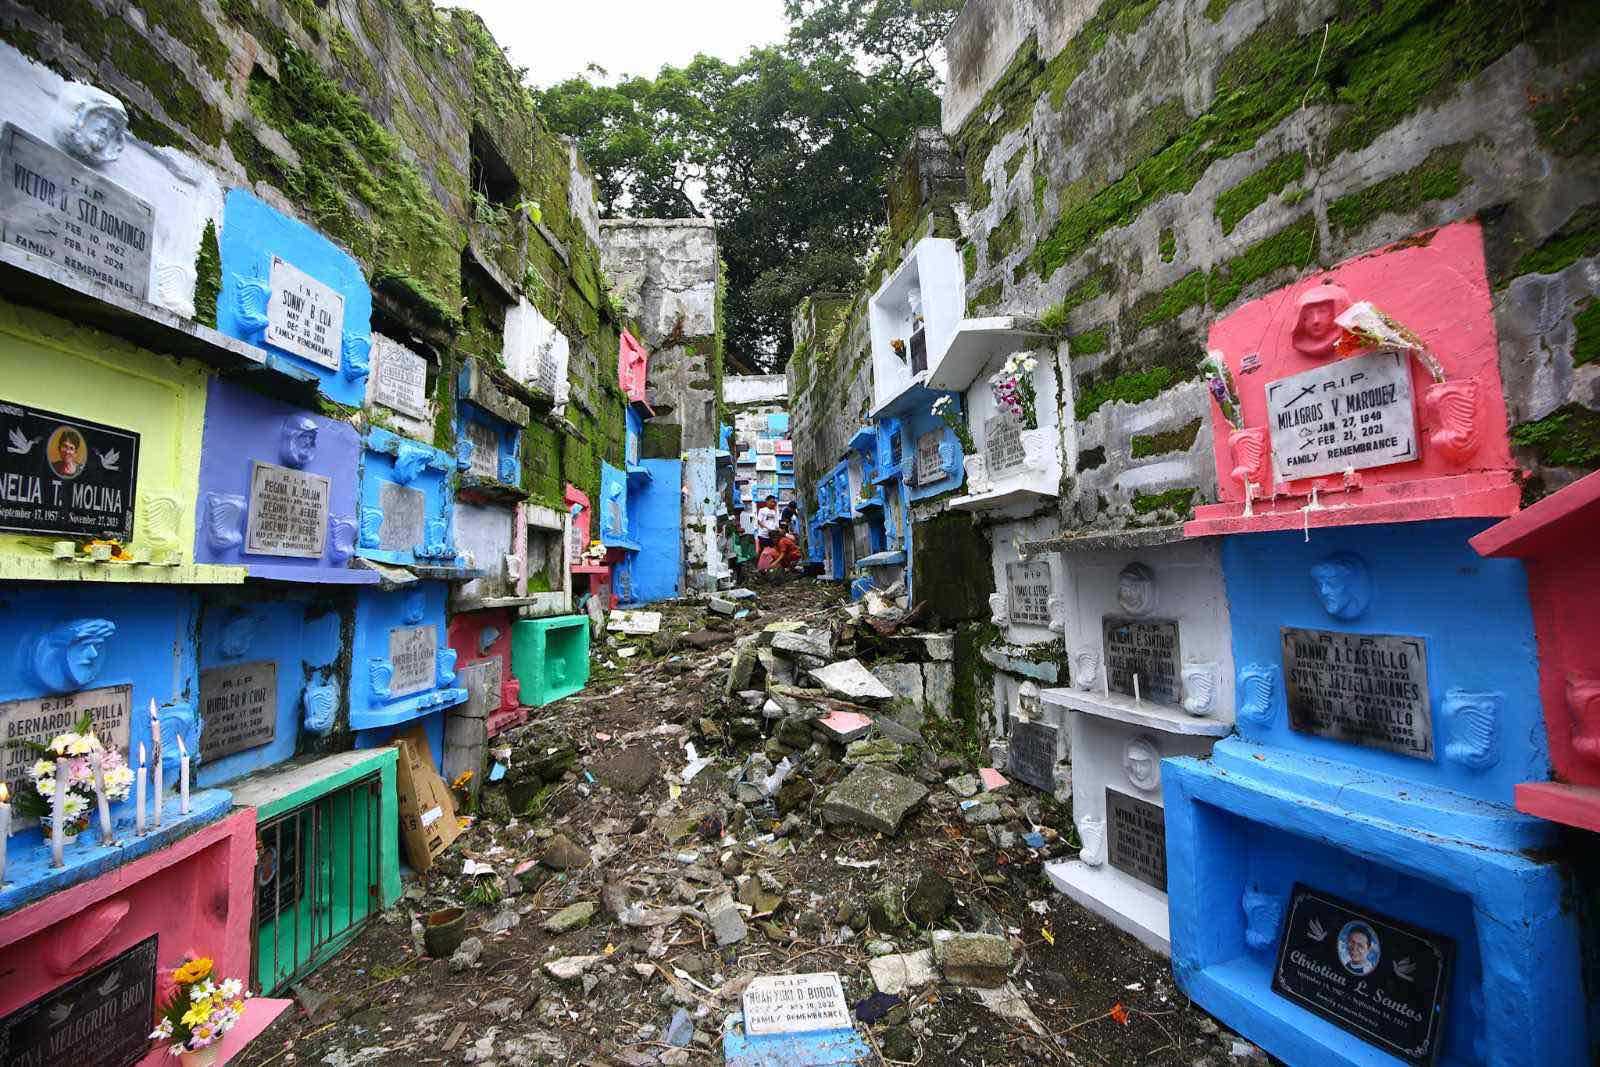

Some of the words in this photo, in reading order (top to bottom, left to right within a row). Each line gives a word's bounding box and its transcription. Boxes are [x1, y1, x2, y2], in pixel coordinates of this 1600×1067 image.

[16, 235, 55, 258] FAMILY
[64, 256, 134, 293] REMEMBRANCE
[1277, 402, 1323, 430] MILAGROS
[1347, 383, 1397, 413] MARQUEZ
[1287, 452, 1318, 467] FAMILY
[1327, 436, 1398, 459] REMEMBRANCE
[52, 479, 62, 506] T.
[72, 482, 122, 514] MOLINA
[8, 712, 70, 738] BERNARDO
[786, 1010, 843, 1021] REMEMBRANCE
[1373, 988, 1423, 1023] Santos
